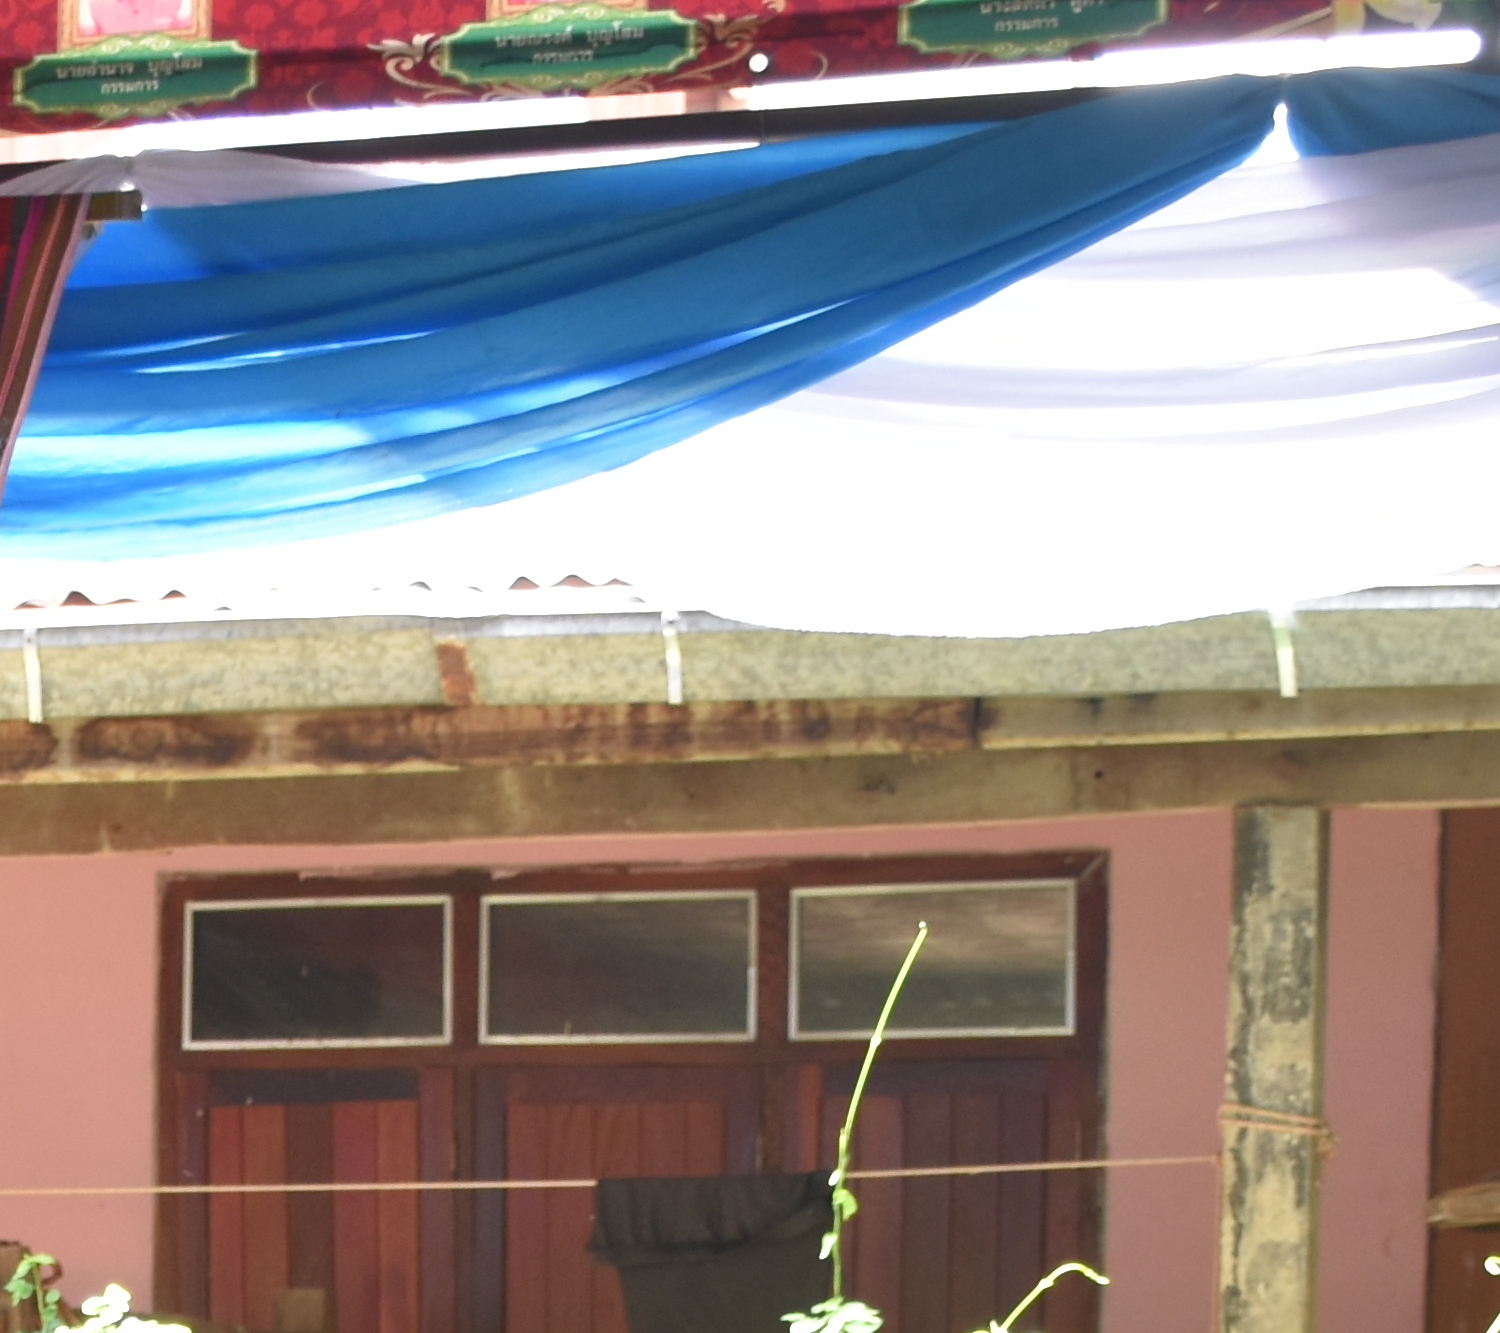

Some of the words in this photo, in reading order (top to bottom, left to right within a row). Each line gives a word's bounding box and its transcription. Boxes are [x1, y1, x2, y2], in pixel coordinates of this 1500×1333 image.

[994, 17, 1060, 32] กรรมการ
[532, 50, 594, 64] กรรมการ
[101, 79, 160, 94] กรรมการ
